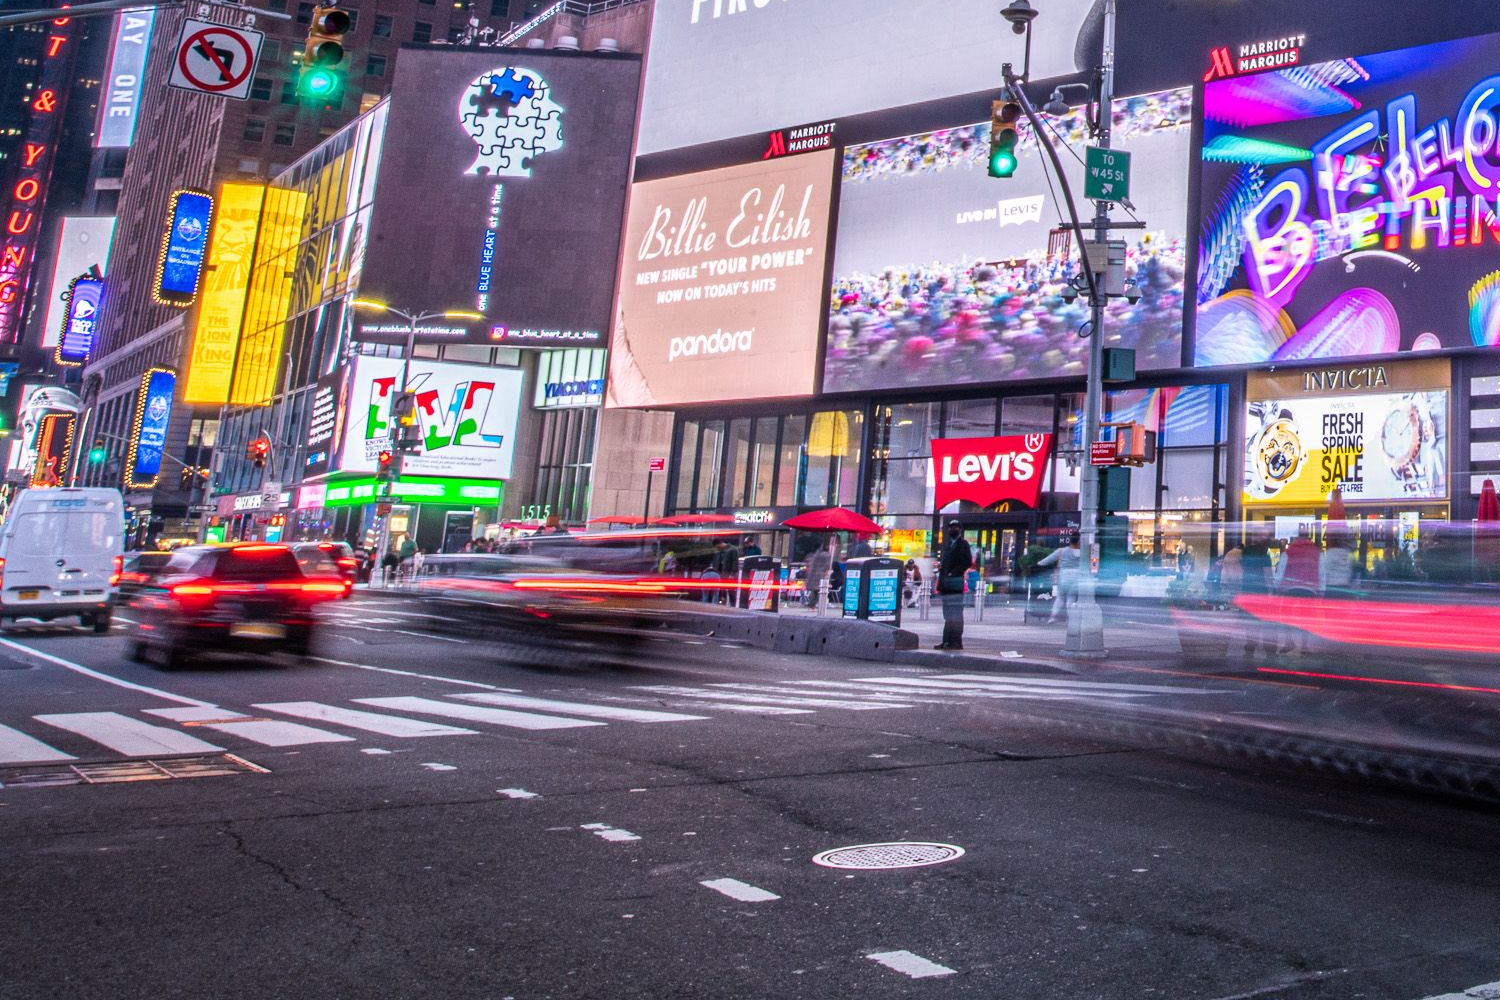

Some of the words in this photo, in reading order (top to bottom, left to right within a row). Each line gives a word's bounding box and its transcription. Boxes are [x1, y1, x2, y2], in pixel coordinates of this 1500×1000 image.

[121, 6, 148, 45] AY
[1240, 34, 1305, 58] MARRIOTT
[1239, 48, 1298, 72] MARQUIS
[33, 90, 56, 112] &
[109, 74, 136, 118] ONE
[790, 122, 836, 139] MARRIOTT
[789, 135, 829, 151] MARQUIS
[1103, 154, 1114, 165] TO
[1092, 168, 1099, 178] W
[1100, 169, 1113, 179] 45
[1115, 172, 1124, 182] St
[492, 184, 503, 205] time
[0, 144, 45, 303] YOUNG
[489, 216, 497, 228] at
[637, 196, 716, 261] Billie
[726, 183, 814, 249] Eilish
[957, 210, 982, 224] LIVE
[984, 207, 996, 220] IN
[483, 230, 496, 263] HEART
[636, 269, 660, 286] NEW
[661, 265, 698, 283] SINGLE
[700, 256, 747, 278] "YOUR
[751, 248, 813, 271] POWER"
[478, 266, 491, 291] BLUE
[657, 289, 683, 305] NOW
[685, 287, 702, 302] ON
[703, 281, 749, 299] TODAY'S
[751, 277, 777, 293] HITS
[478, 294, 488, 311] one
[71, 319, 91, 328] TACO
[207, 315, 229, 327] THE
[361, 325, 466, 336] www.onebluehartatatime.com
[201, 327, 231, 343] LION
[668, 327, 753, 363] pandora
[196, 344, 233, 366] KING
[1304, 367, 1388, 392] INVICTA
[1322, 412, 1364, 435] FRESH
[1321, 435, 1364, 455] SPRING
[1321, 454, 1364, 483] SALE
[264, 493, 278, 501] 25
[1321, 484, 1331, 493] BUY
[1336, 483, 1346, 493] GET
[1351, 483, 1363, 492] FREE
[521, 505, 550, 520] 1515
